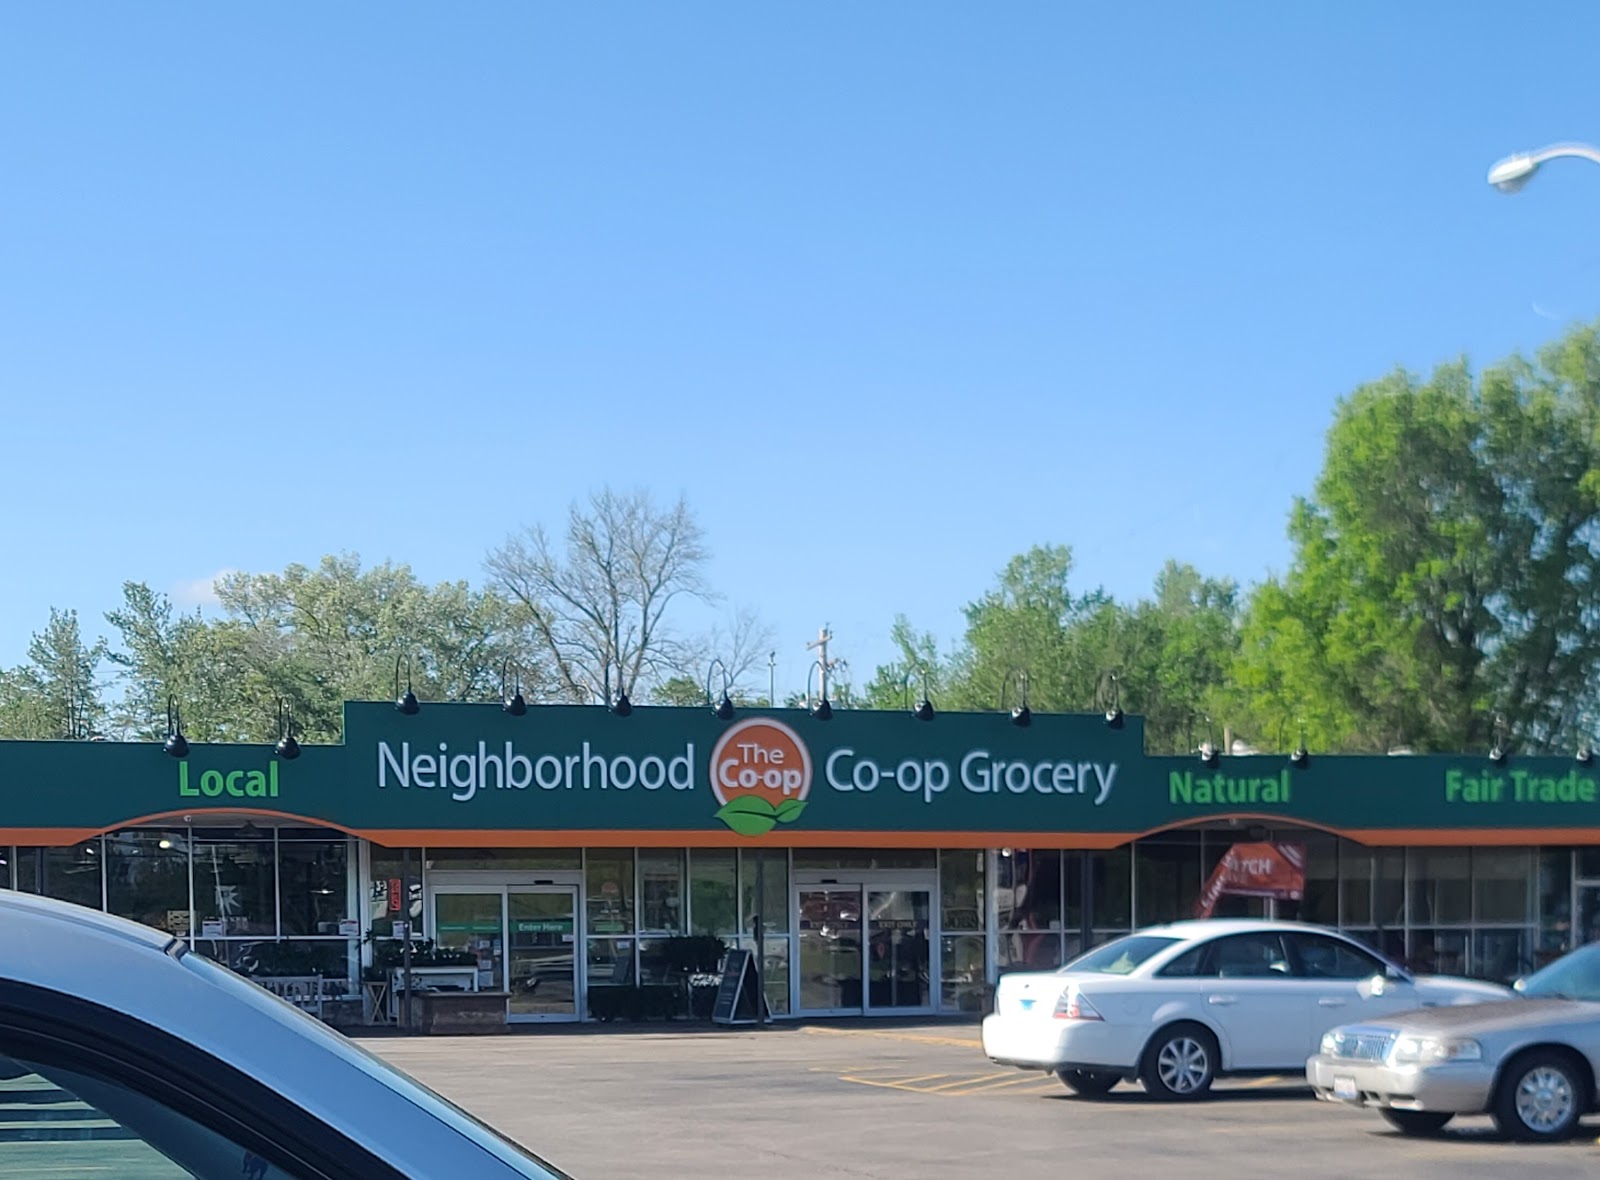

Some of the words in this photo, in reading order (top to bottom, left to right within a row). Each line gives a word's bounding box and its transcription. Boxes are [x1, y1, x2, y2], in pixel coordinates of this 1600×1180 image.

[737, 743, 785, 764] The
[179, 760, 279, 798] Local
[378, 741, 694, 802] Neighborhood
[826, 748, 949, 803] Co-op
[960, 750, 1118, 805] Grocery
[719, 758, 802, 795] Co-op
[1169, 769, 1290, 804] Natural
[1445, 769, 1503, 802] Fair
[1509, 769, 1596, 803] Trade
[518, 923, 542, 932] Enter
